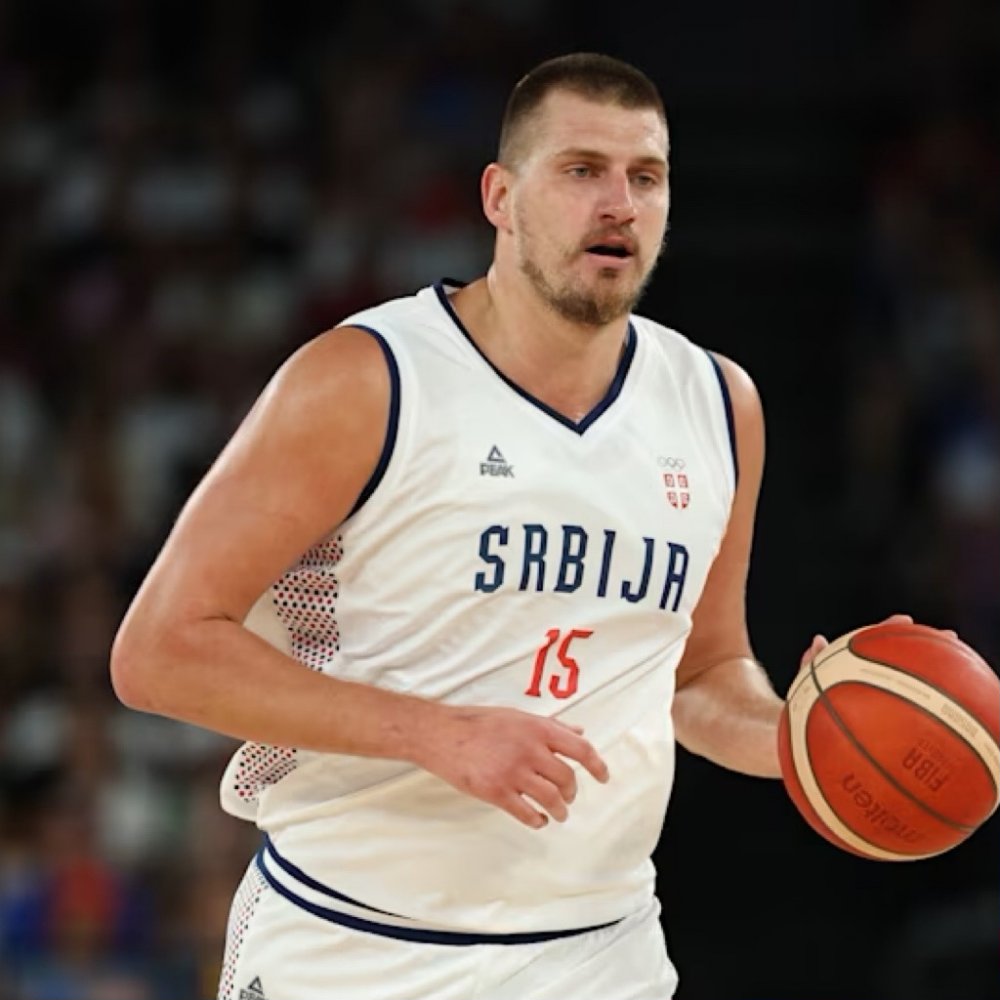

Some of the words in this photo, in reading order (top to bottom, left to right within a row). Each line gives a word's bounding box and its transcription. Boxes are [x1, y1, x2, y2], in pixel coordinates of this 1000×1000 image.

[480, 462, 515, 478] PEAK
[474, 523, 689, 612] SRBIJA
[524, 629, 594, 699] 15
